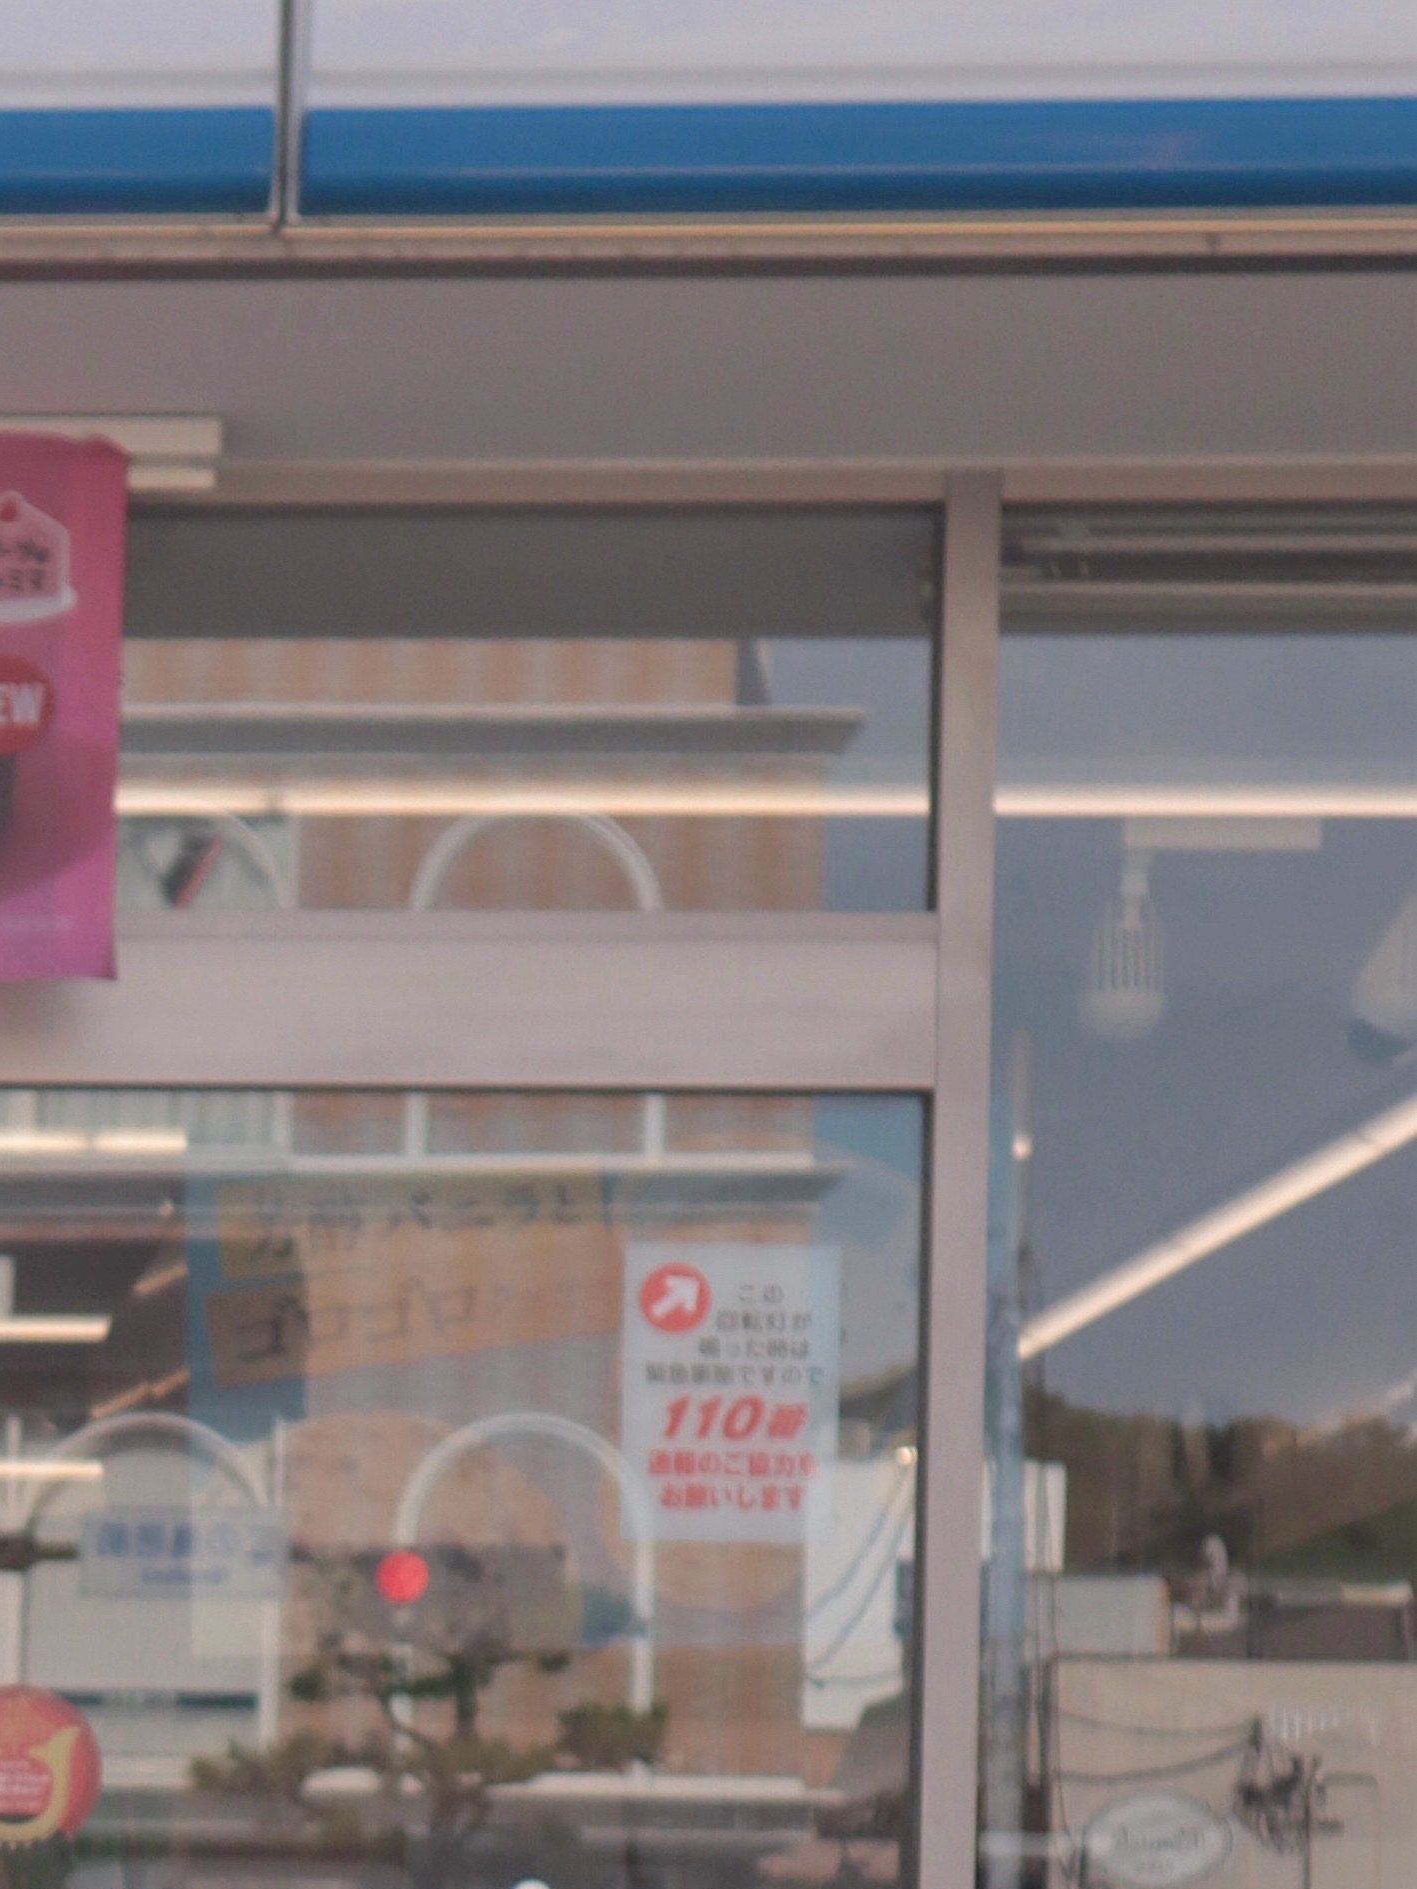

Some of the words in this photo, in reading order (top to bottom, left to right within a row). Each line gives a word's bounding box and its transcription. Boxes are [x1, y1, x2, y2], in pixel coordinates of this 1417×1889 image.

[663, 1394, 809, 1441] 110番
[659, 1482, 804, 1511] お願いします
